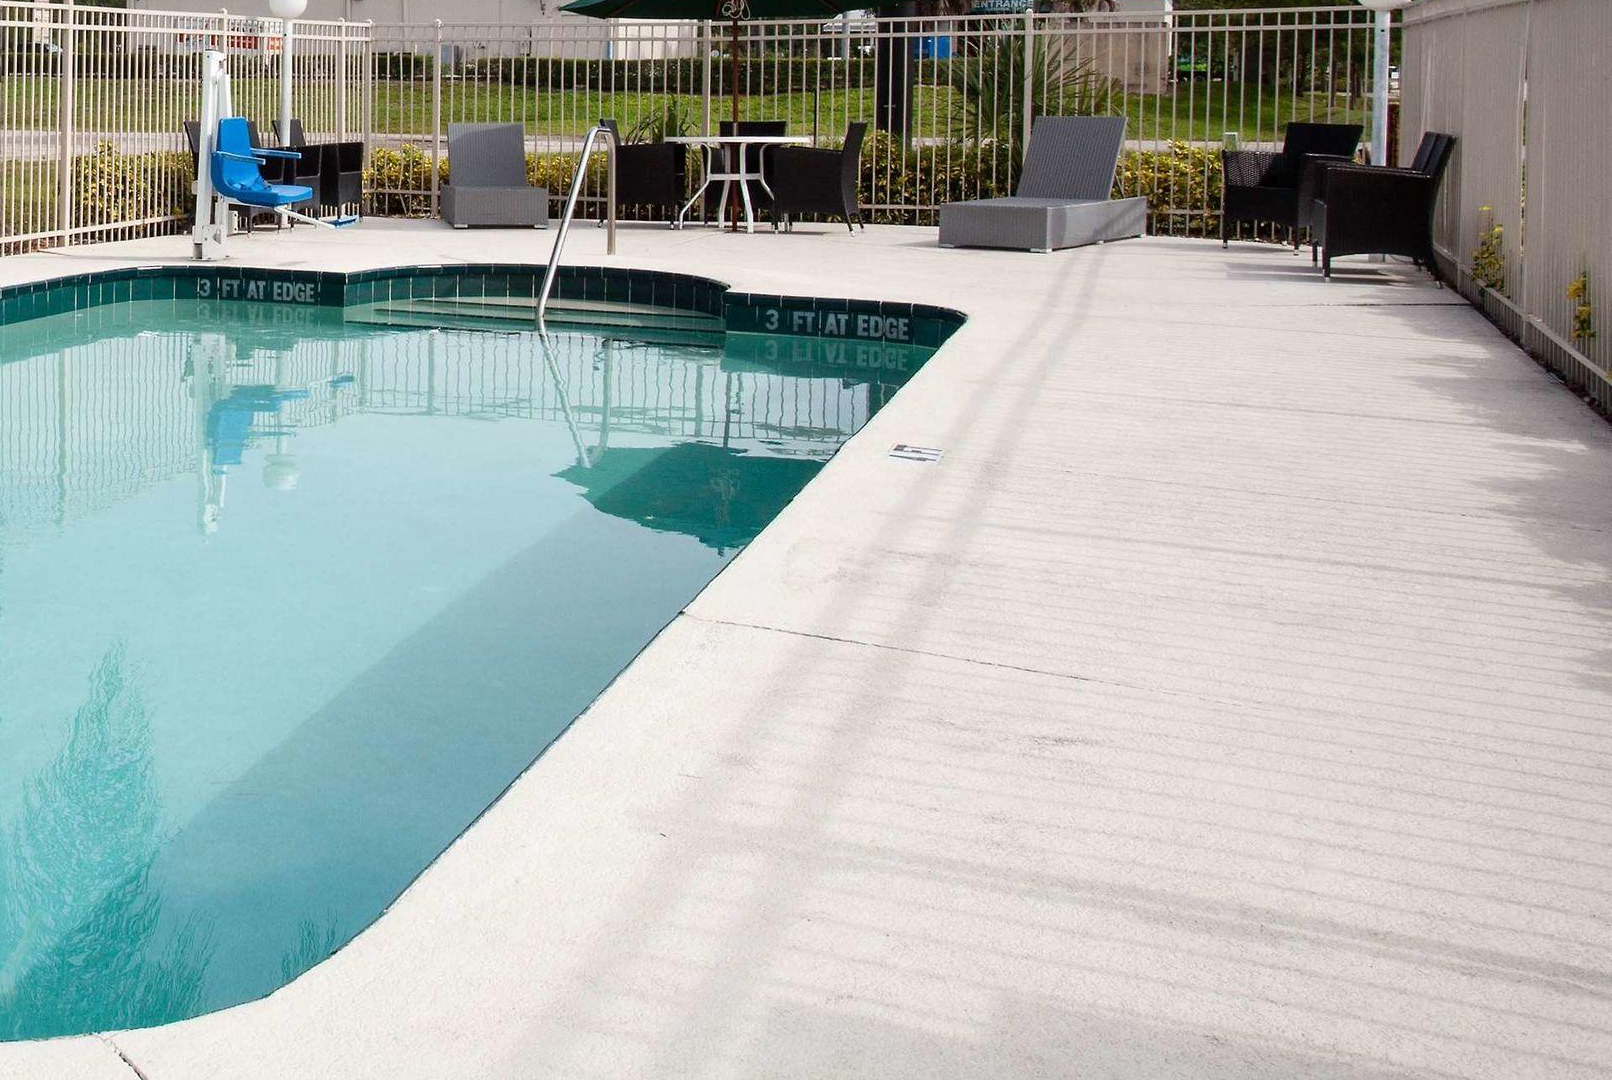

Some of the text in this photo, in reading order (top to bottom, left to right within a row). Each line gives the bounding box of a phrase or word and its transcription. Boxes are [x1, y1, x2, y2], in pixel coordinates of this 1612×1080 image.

[974, 0, 1034, 9] ENTRANCE
[200, 279, 315, 302] 3 FT AT EDGE
[765, 309, 909, 340] 3 FT AT EDGE
